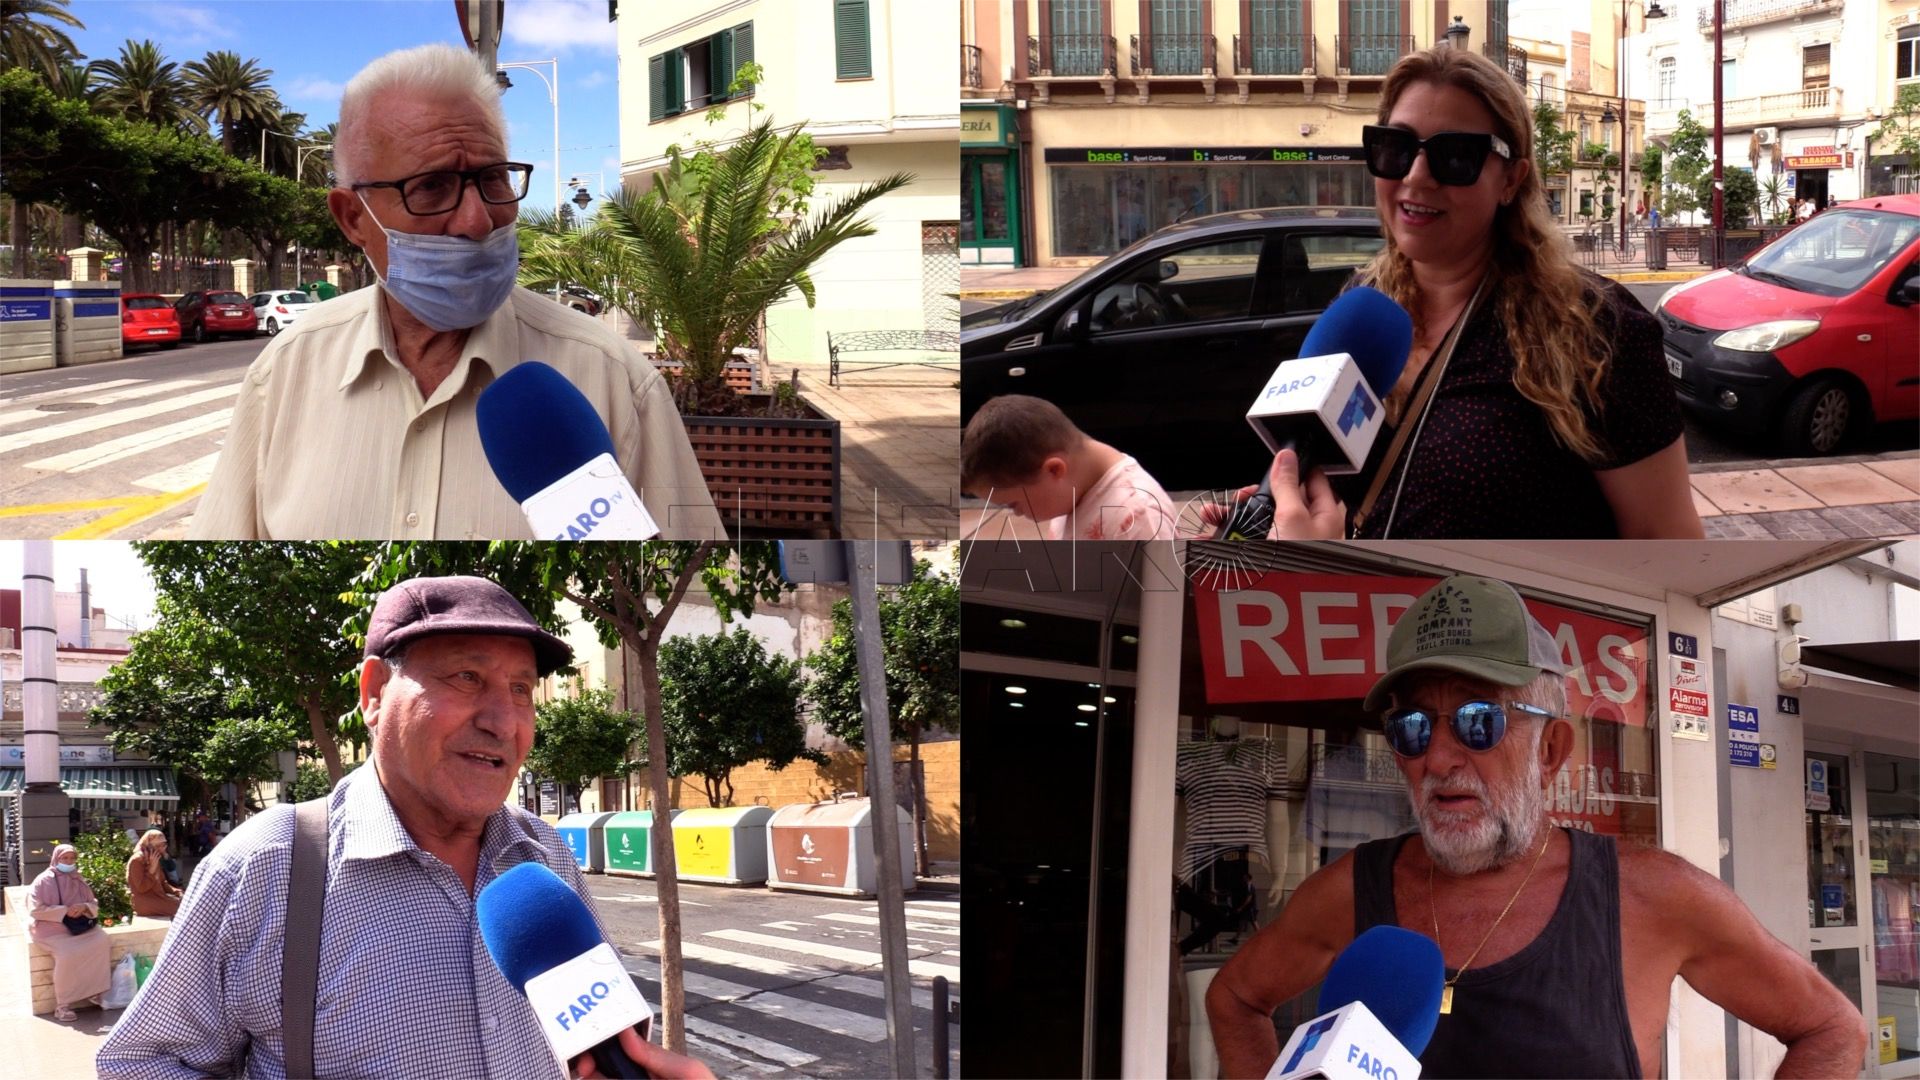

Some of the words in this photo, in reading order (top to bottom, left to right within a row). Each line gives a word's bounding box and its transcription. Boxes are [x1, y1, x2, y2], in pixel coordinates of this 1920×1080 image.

[1800, 156, 1838, 164] TABACOS
[1266, 375, 1316, 399] FARO
[609, 491, 623, 505] TV
[1417, 617, 1472, 635] COMPANY
[1416, 641, 1437, 654] SKULL
[1675, 636, 1684, 652] 6
[1671, 690, 1707, 706] Alarma
[1782, 698, 1789, 711] 4
[1728, 709, 1756, 724] ESA
[555, 981, 609, 1032] FARO
[1347, 1043, 1398, 1080] FARO
